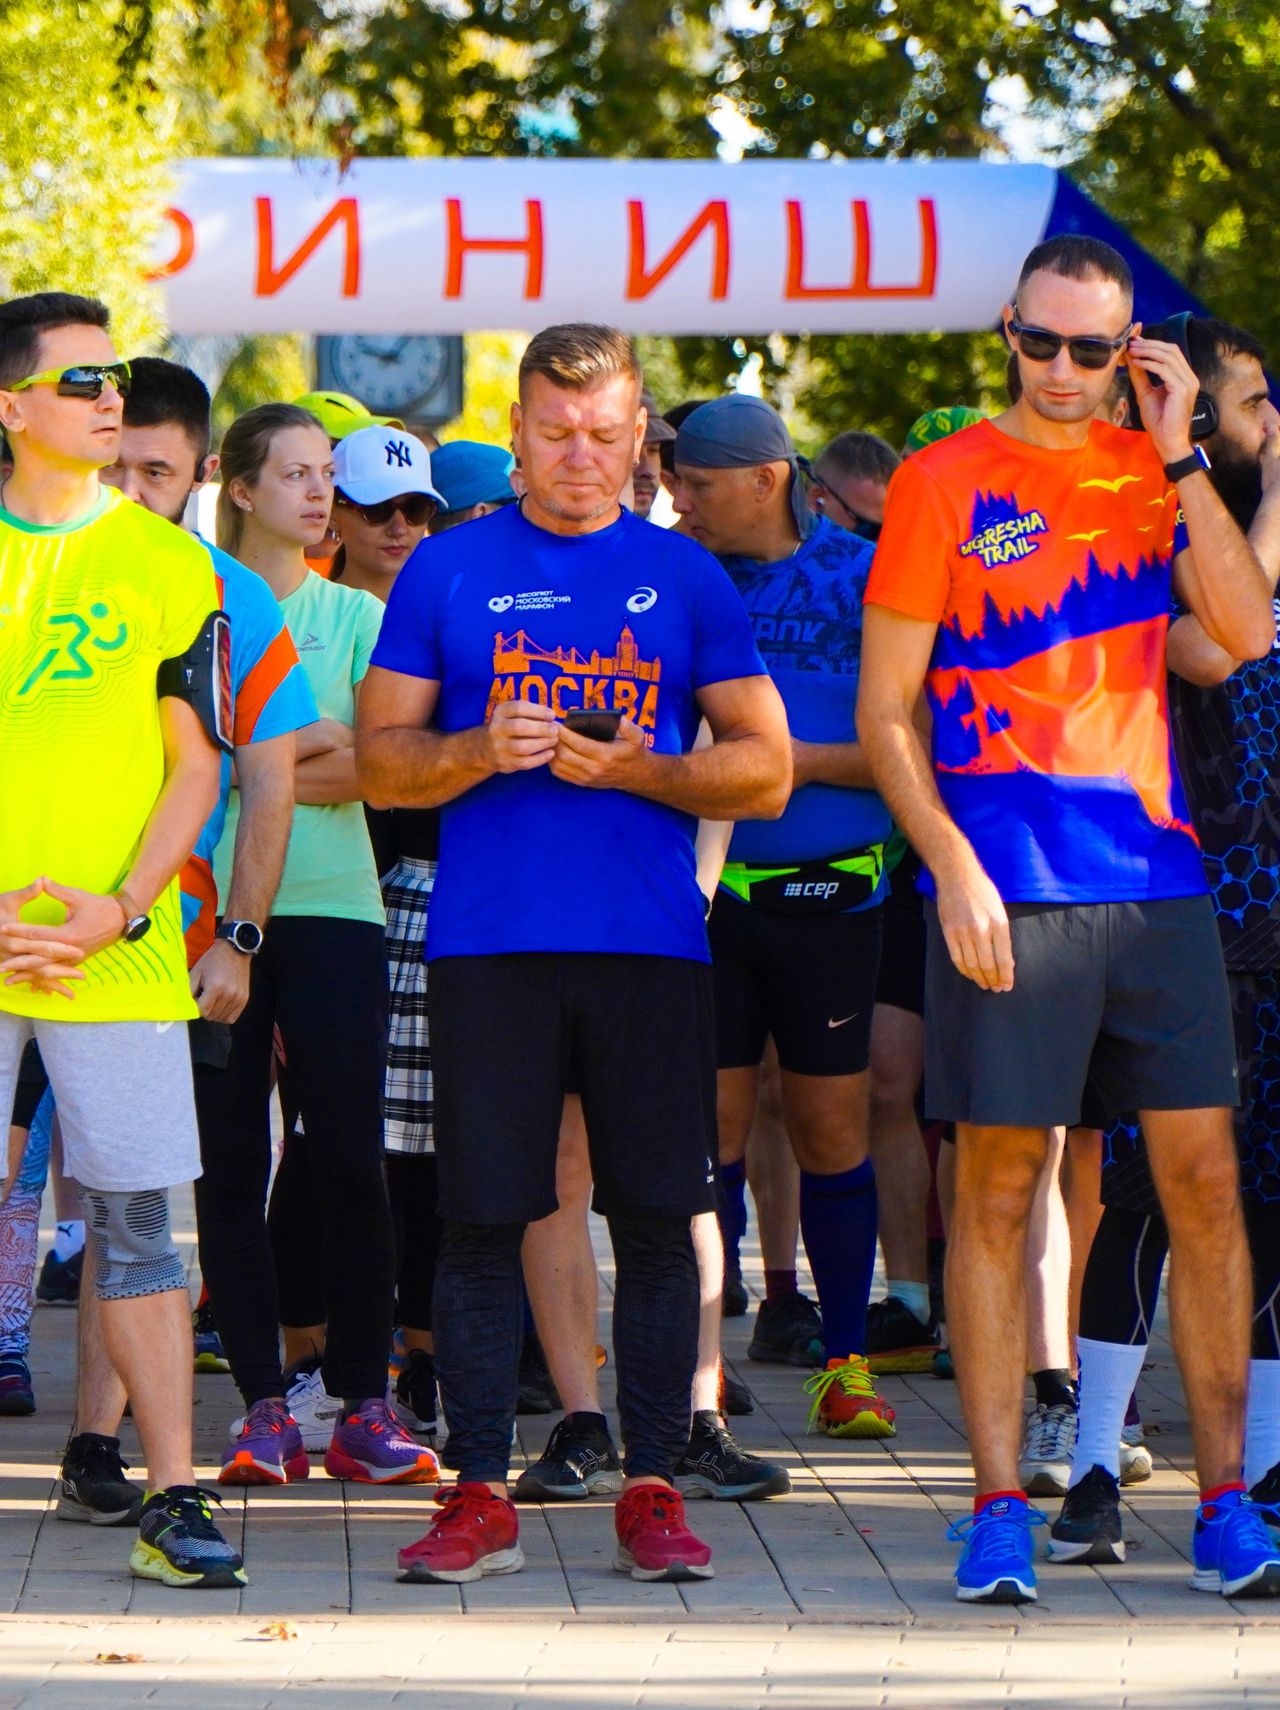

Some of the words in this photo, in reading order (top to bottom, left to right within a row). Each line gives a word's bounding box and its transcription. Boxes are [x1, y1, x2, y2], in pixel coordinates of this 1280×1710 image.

[384, 440, 413, 468] NY
[960, 511, 1046, 556] UGRESHA
[978, 536, 1038, 568] TRAIL
[514, 603, 555, 611] МАРАФОН
[515, 596, 571, 605] МОСКОВСКИЙ
[484, 675, 659, 729] МОСКВА
[802, 882, 840, 900] cep
